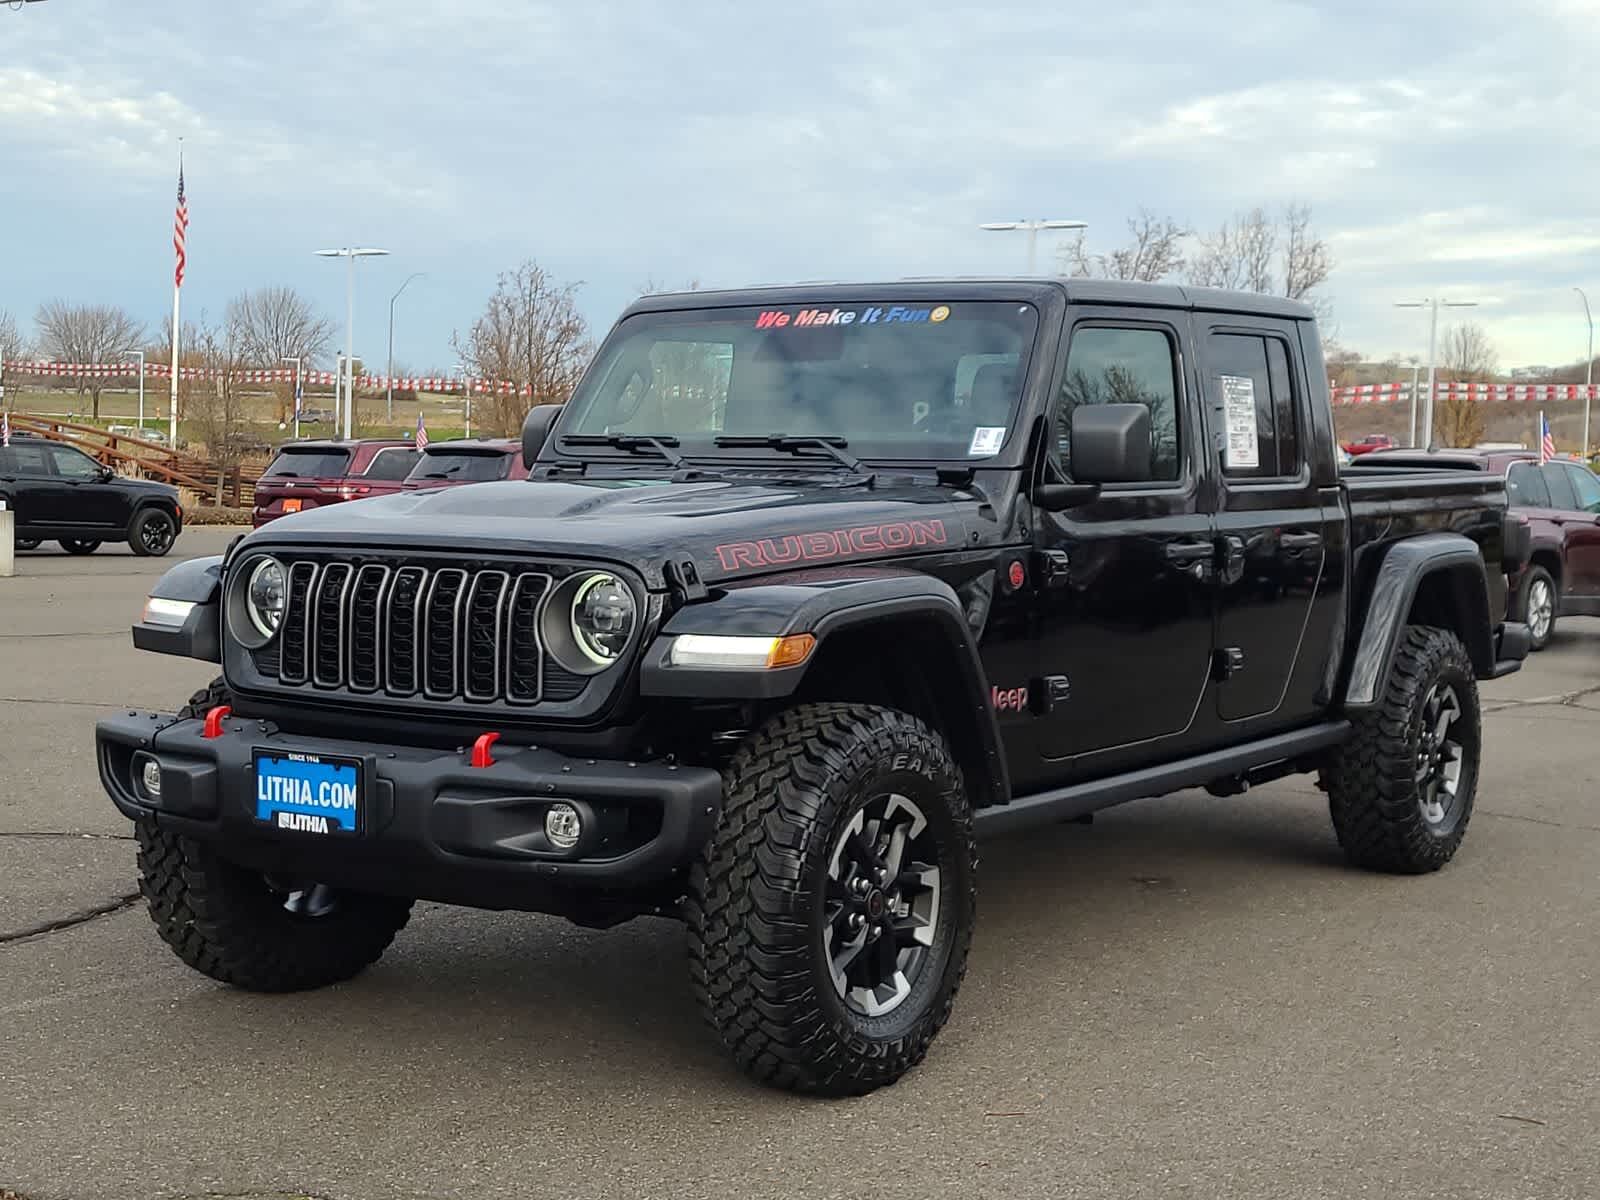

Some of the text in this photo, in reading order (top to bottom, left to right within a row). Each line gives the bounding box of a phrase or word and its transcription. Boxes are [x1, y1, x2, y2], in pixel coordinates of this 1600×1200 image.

[755, 306, 930, 329] We Make It Fun
[715, 519, 947, 571] RUBICON
[991, 685, 1029, 712] Jeep
[258, 774, 357, 810] LITHIA.COM
[290, 813, 328, 834] LITHIA
